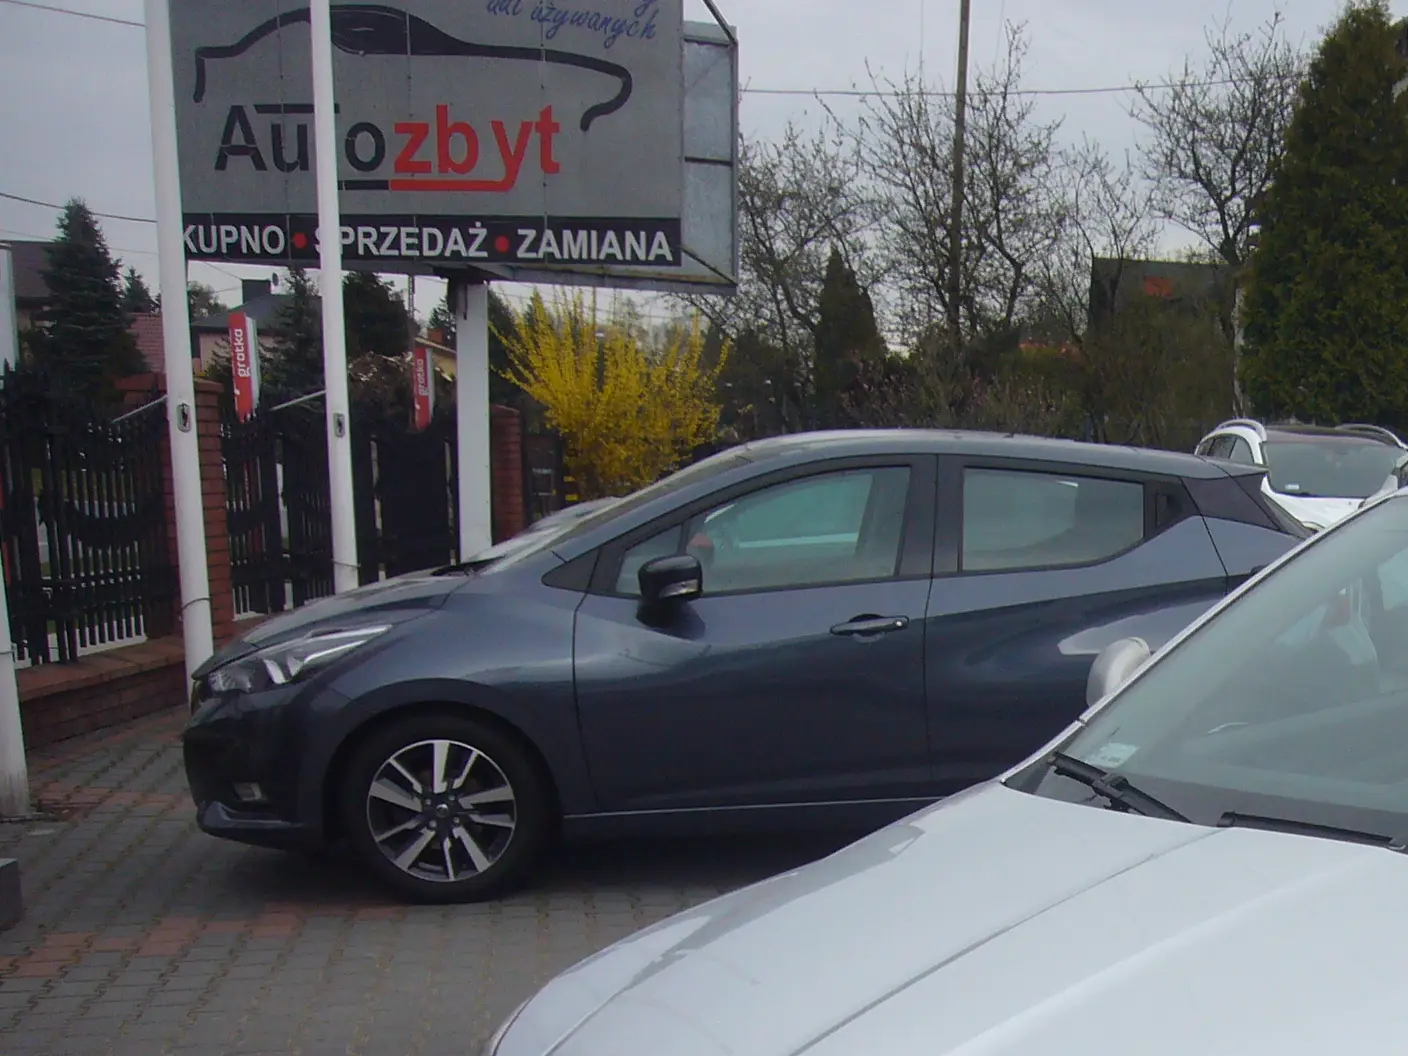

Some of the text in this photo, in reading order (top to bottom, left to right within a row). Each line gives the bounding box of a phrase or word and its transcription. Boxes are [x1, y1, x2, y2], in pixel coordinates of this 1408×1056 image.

[214, 103, 561, 192] Auozbyt
[183, 221, 673, 262] KUPNO PRZEDAŻ ZAMIANA
[234, 328, 251, 377] gratka
